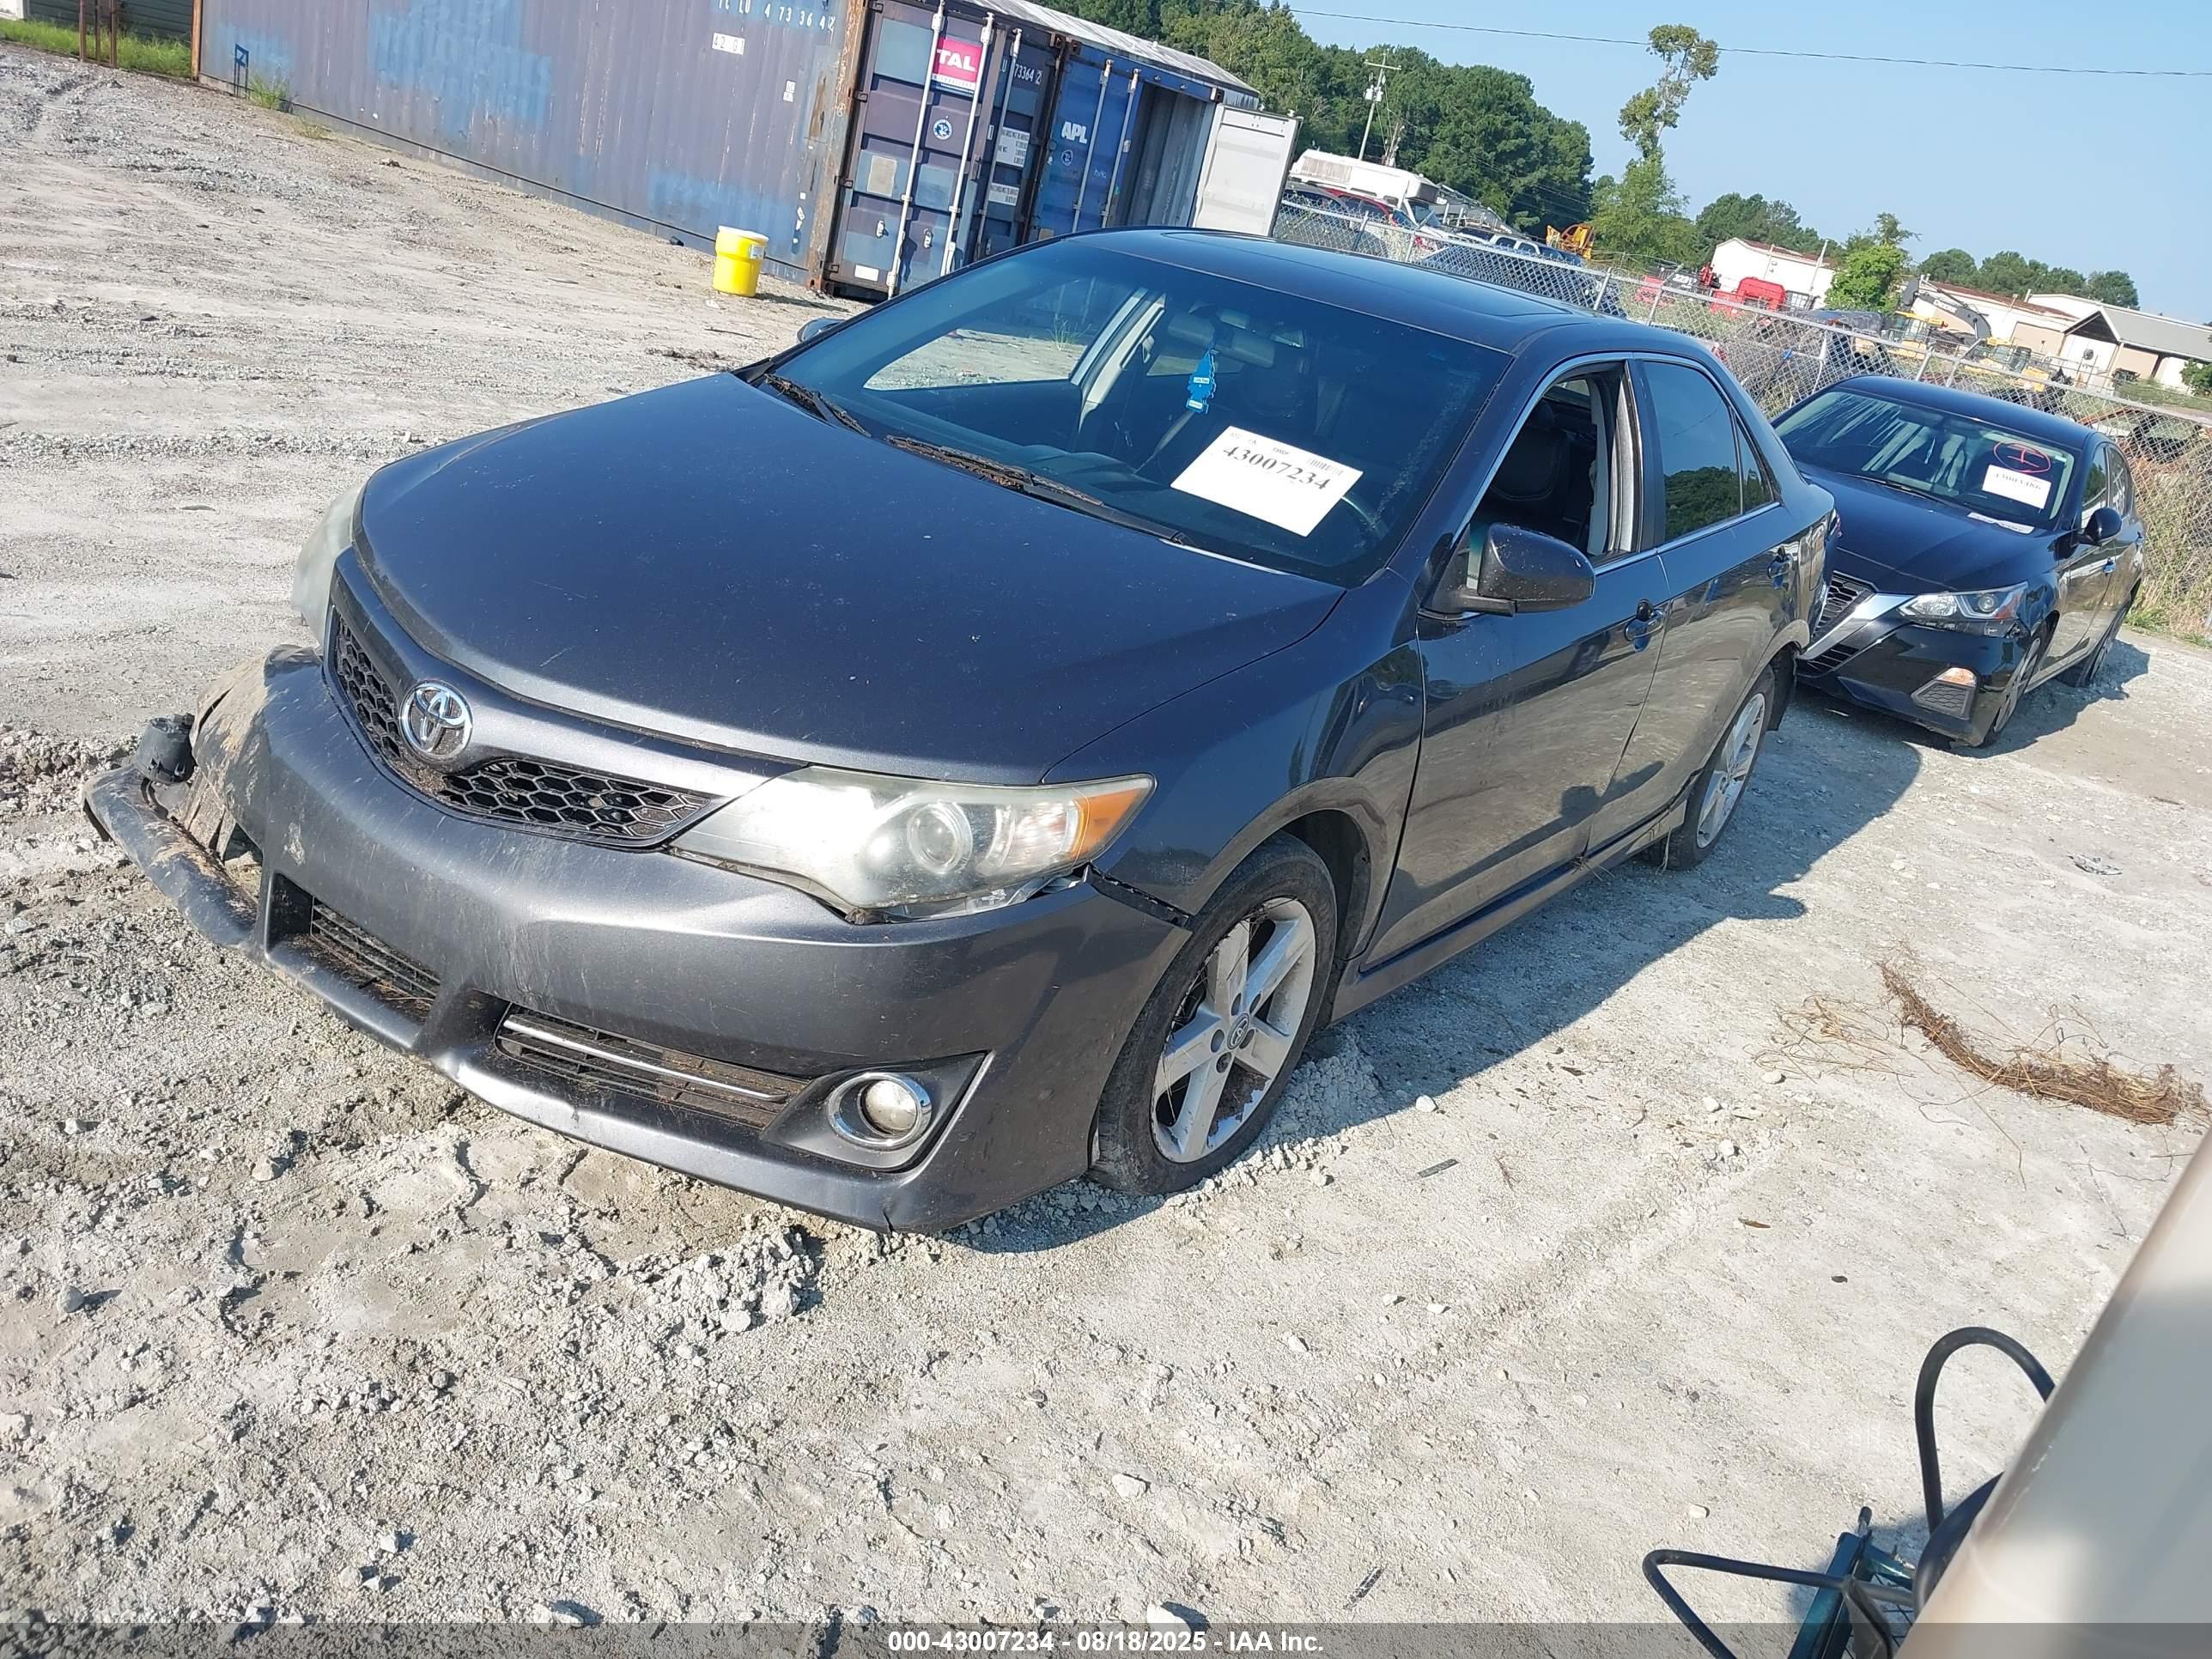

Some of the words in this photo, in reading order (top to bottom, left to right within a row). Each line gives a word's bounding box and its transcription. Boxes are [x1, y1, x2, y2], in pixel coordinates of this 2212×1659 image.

[937, 49, 976, 72] TAL
[1014, 64, 1035, 82] 73364
[1061, 121, 1087, 144] APL
[1223, 447, 1330, 489] 43007234
